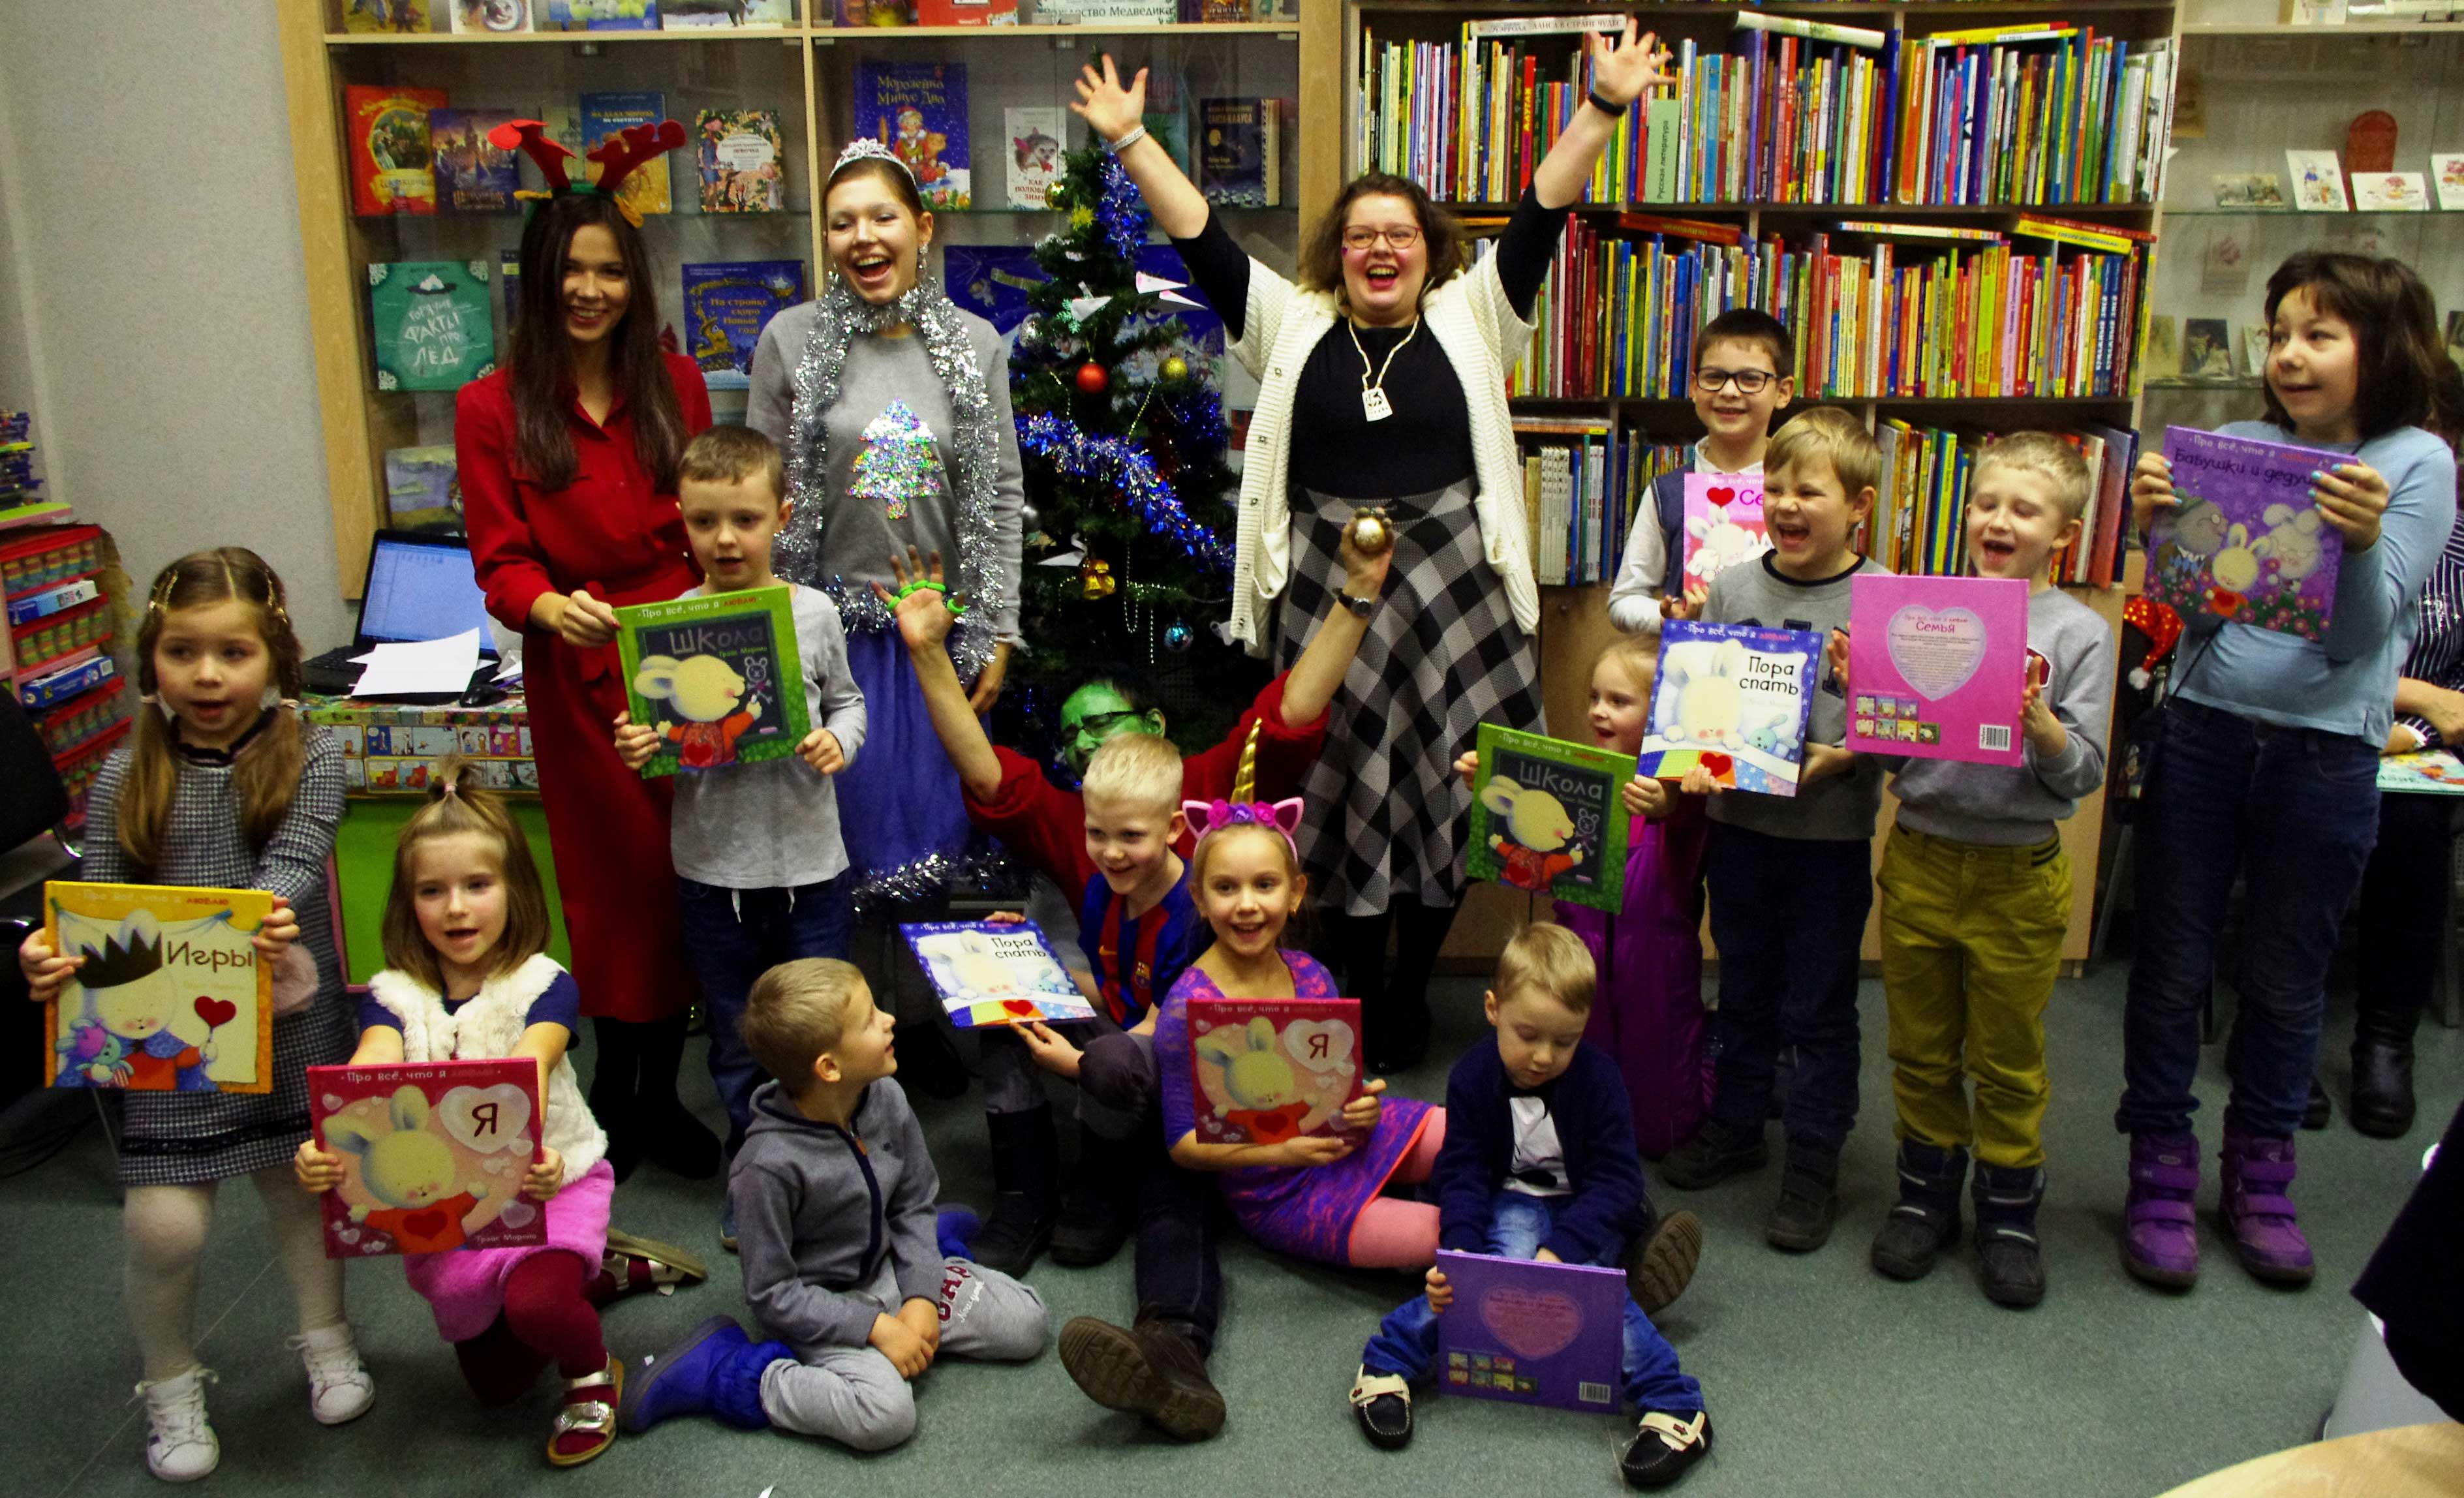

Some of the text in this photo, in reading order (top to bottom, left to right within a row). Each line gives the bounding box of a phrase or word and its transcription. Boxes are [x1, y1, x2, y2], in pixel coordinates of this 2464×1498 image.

[1110, 6, 1172, 18] Медведика
[1657, 120, 1670, 200] Русская литература
[405, 311, 461, 344] ФАКТЫ
[413, 345, 459, 367] ЛЁД
[2193, 435, 2213, 449] Про
[2241, 445, 2265, 455] что
[2172, 447, 2245, 476] Бабушки
[2251, 466, 2260, 476] и
[642, 608, 662, 619] Про
[688, 604, 709, 612] что
[1687, 624, 1705, 635] Про
[1728, 629, 1747, 637] что
[1916, 621, 1956, 634] Семья
[1749, 655, 1794, 679] Пора
[1739, 677, 1799, 696] спать
[1503, 732, 1519, 745] Про
[1543, 744, 1562, 754] что
[1519, 760, 1604, 801] Школа
[991, 938, 1033, 950] Пора
[995, 948, 1047, 959] спать
[167, 940, 253, 973] Игры
[1214, 1004, 1233, 1014] Про
[1308, 1033, 1329, 1059] Я
[347, 1071, 372, 1084] Про
[406, 1071, 433, 1080] что
[472, 1103, 498, 1137] Я
